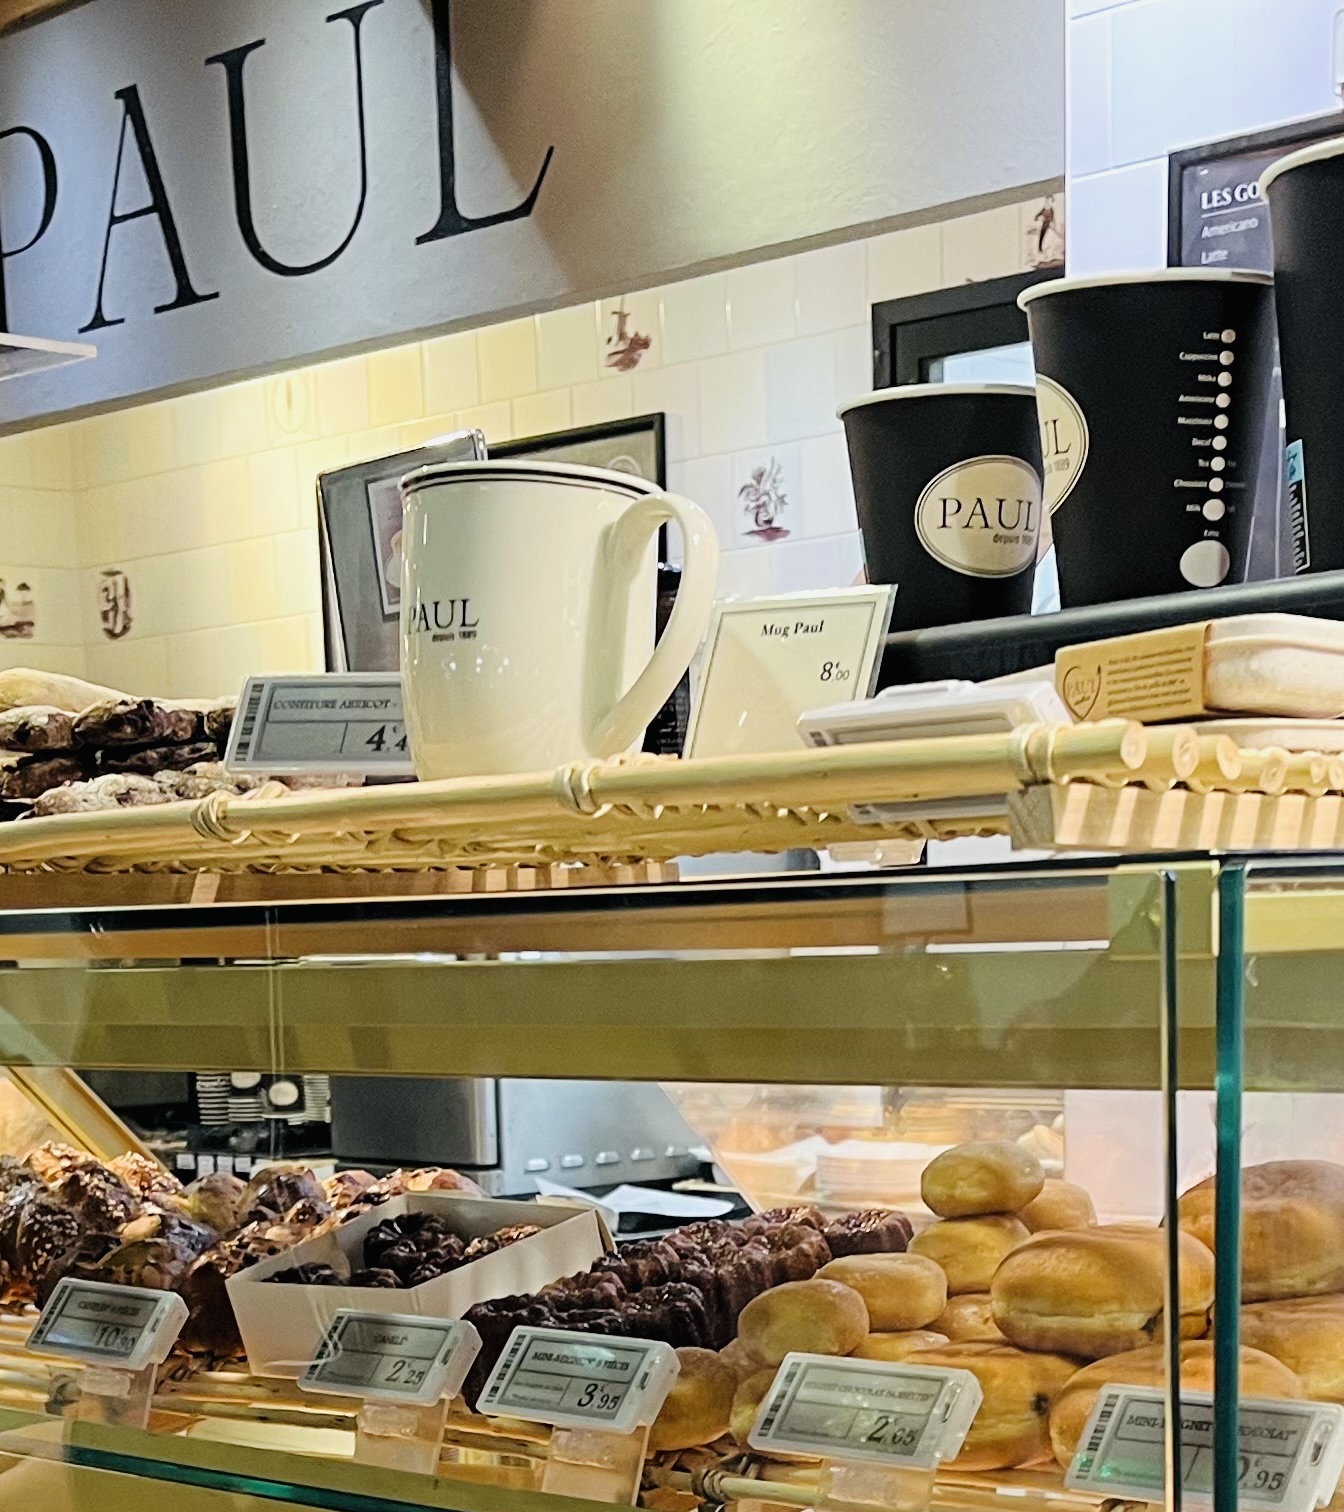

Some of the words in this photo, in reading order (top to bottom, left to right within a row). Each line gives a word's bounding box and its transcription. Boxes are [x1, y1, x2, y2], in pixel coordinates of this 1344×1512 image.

[1200, 187, 1232, 210] LES
[937, 497, 1036, 532] PAUL
[408, 599, 480, 635] PAUL
[761, 623, 791, 638] Mug
[793, 620, 825, 635] Paul
